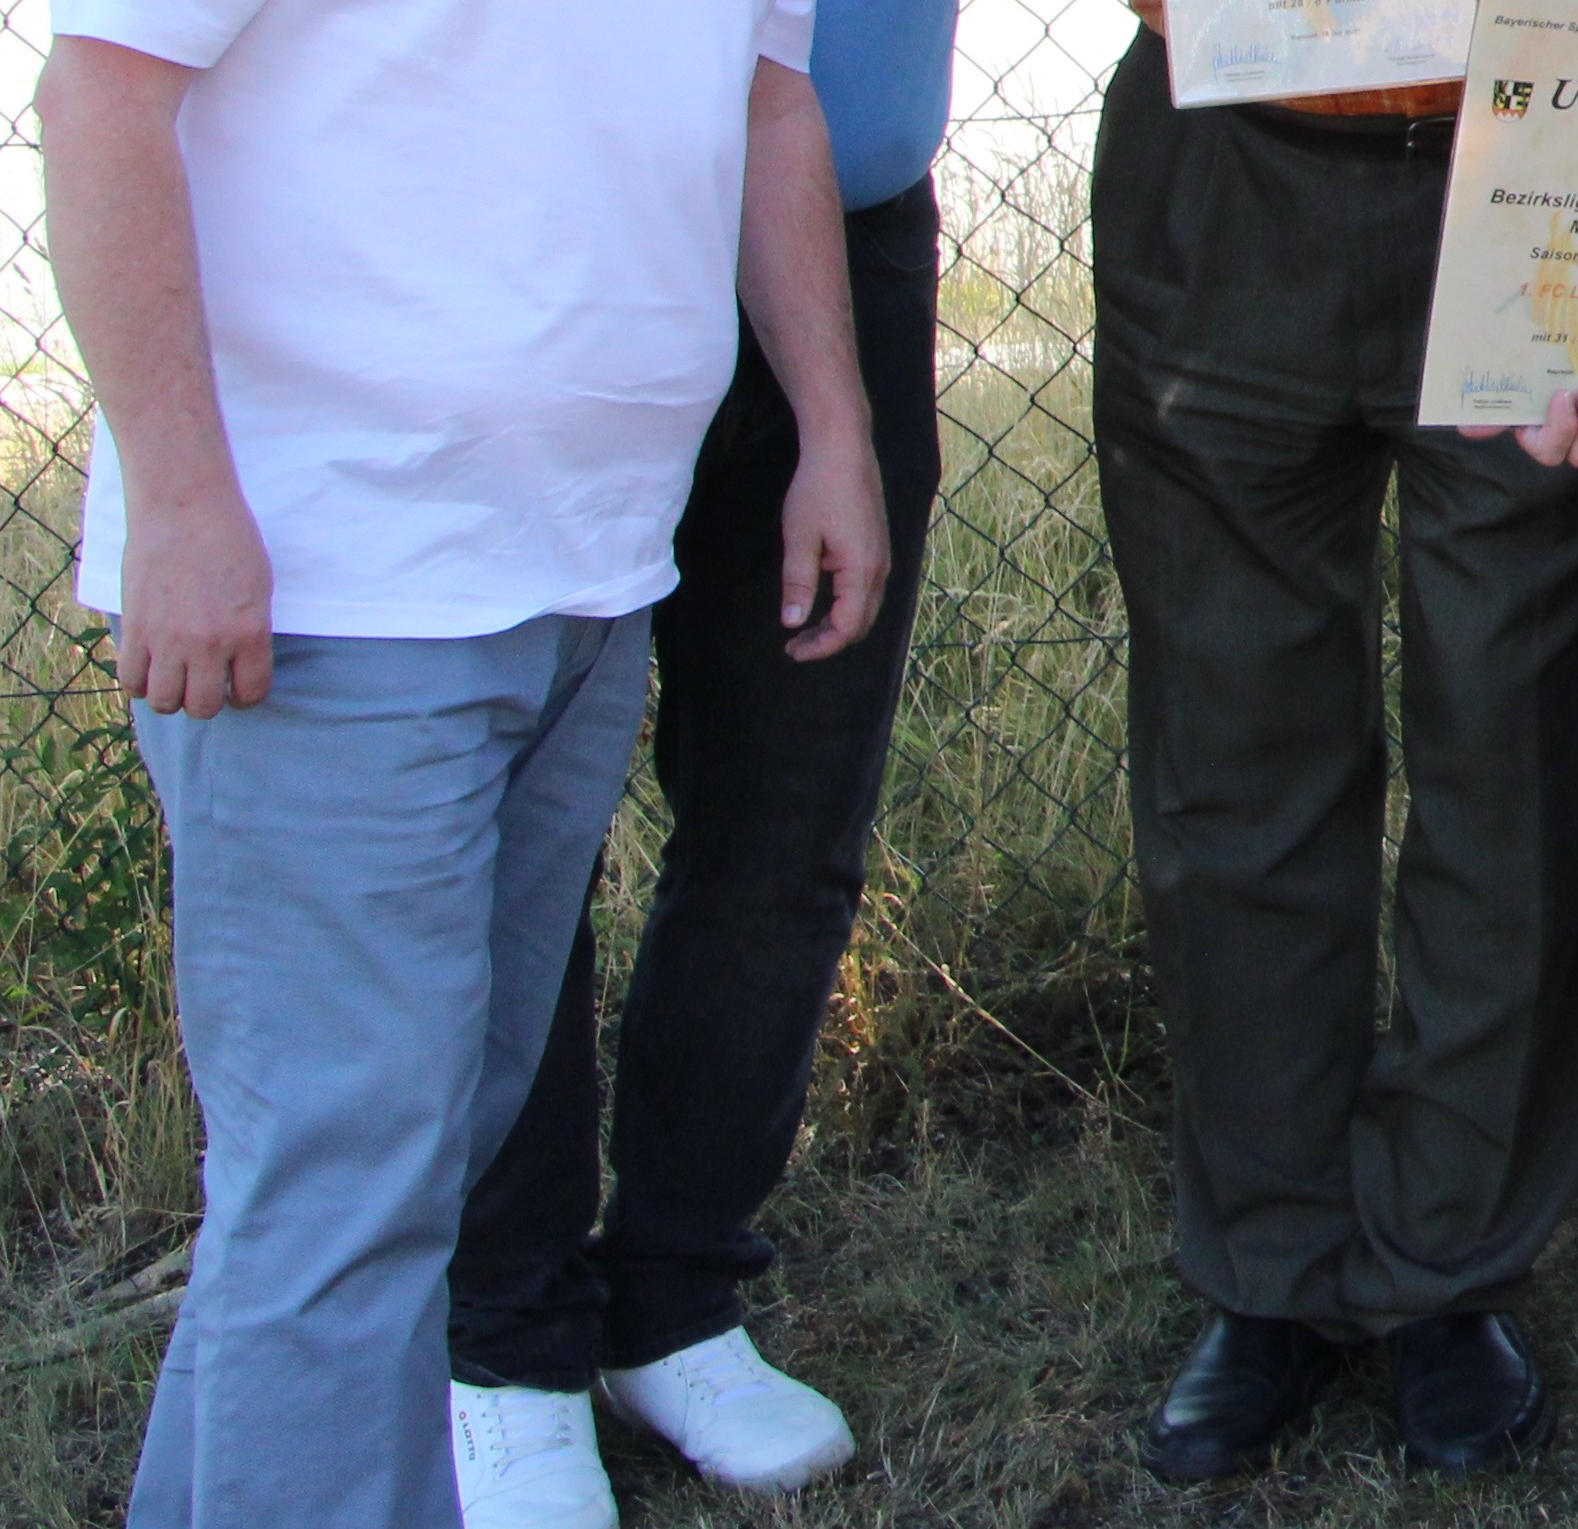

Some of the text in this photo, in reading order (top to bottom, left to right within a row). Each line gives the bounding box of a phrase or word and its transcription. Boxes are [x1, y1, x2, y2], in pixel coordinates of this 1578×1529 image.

[1268, 0, 1286, 10] mit
[1495, 15, 1564, 32] Bayerischer
[1520, 284, 1532, 297] 1.
[1539, 283, 1566, 299] FC
[1531, 333, 1551, 343] mit
[1555, 334, 1568, 344] 31
